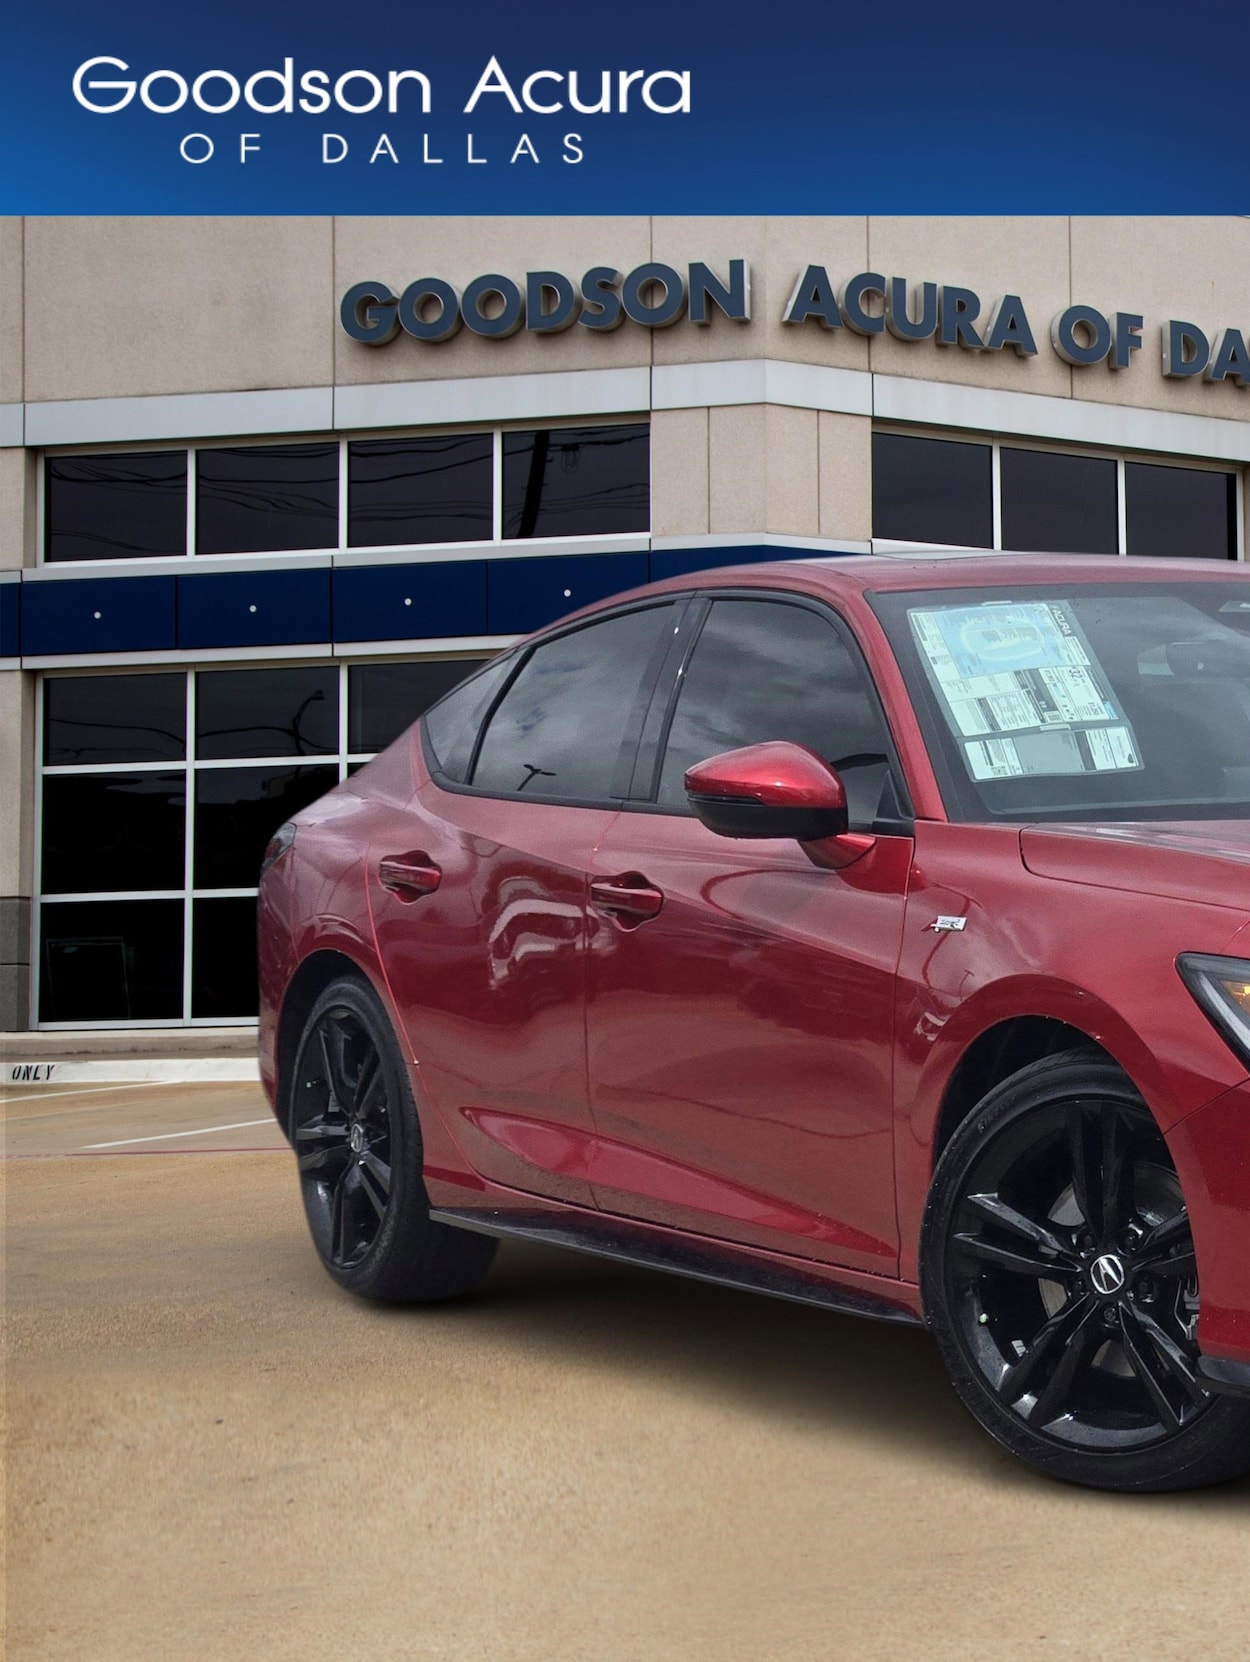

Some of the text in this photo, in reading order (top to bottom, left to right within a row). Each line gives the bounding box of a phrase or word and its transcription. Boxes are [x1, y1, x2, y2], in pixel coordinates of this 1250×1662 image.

[341, 259, 751, 346] GOODSON
[783, 265, 1038, 357] ACURA
[1051, 305, 1144, 369] OF
[1053, 608, 1072, 635] ACURA
[12, 1065, 55, 1080] ONLY
